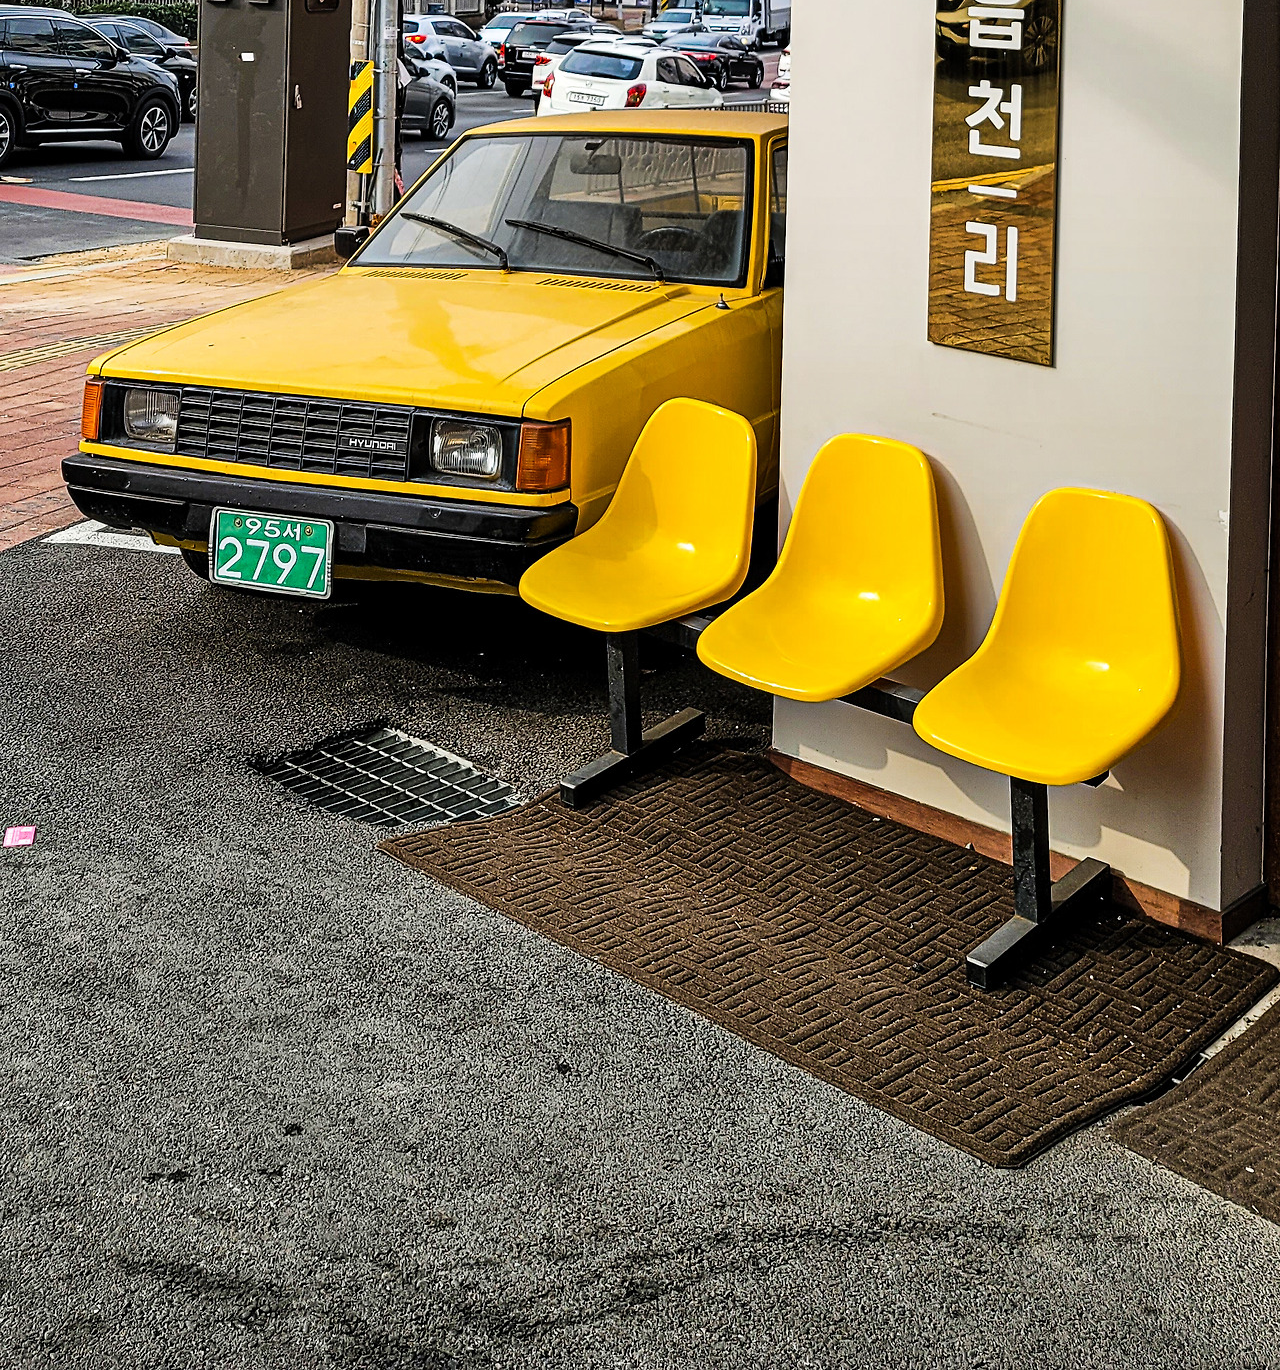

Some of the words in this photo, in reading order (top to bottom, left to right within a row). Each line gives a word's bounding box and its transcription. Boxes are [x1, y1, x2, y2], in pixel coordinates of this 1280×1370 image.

[349, 438, 396, 451] HYUNDAI
[245, 517, 301, 542] 95서
[218, 536, 325, 589] 2797
